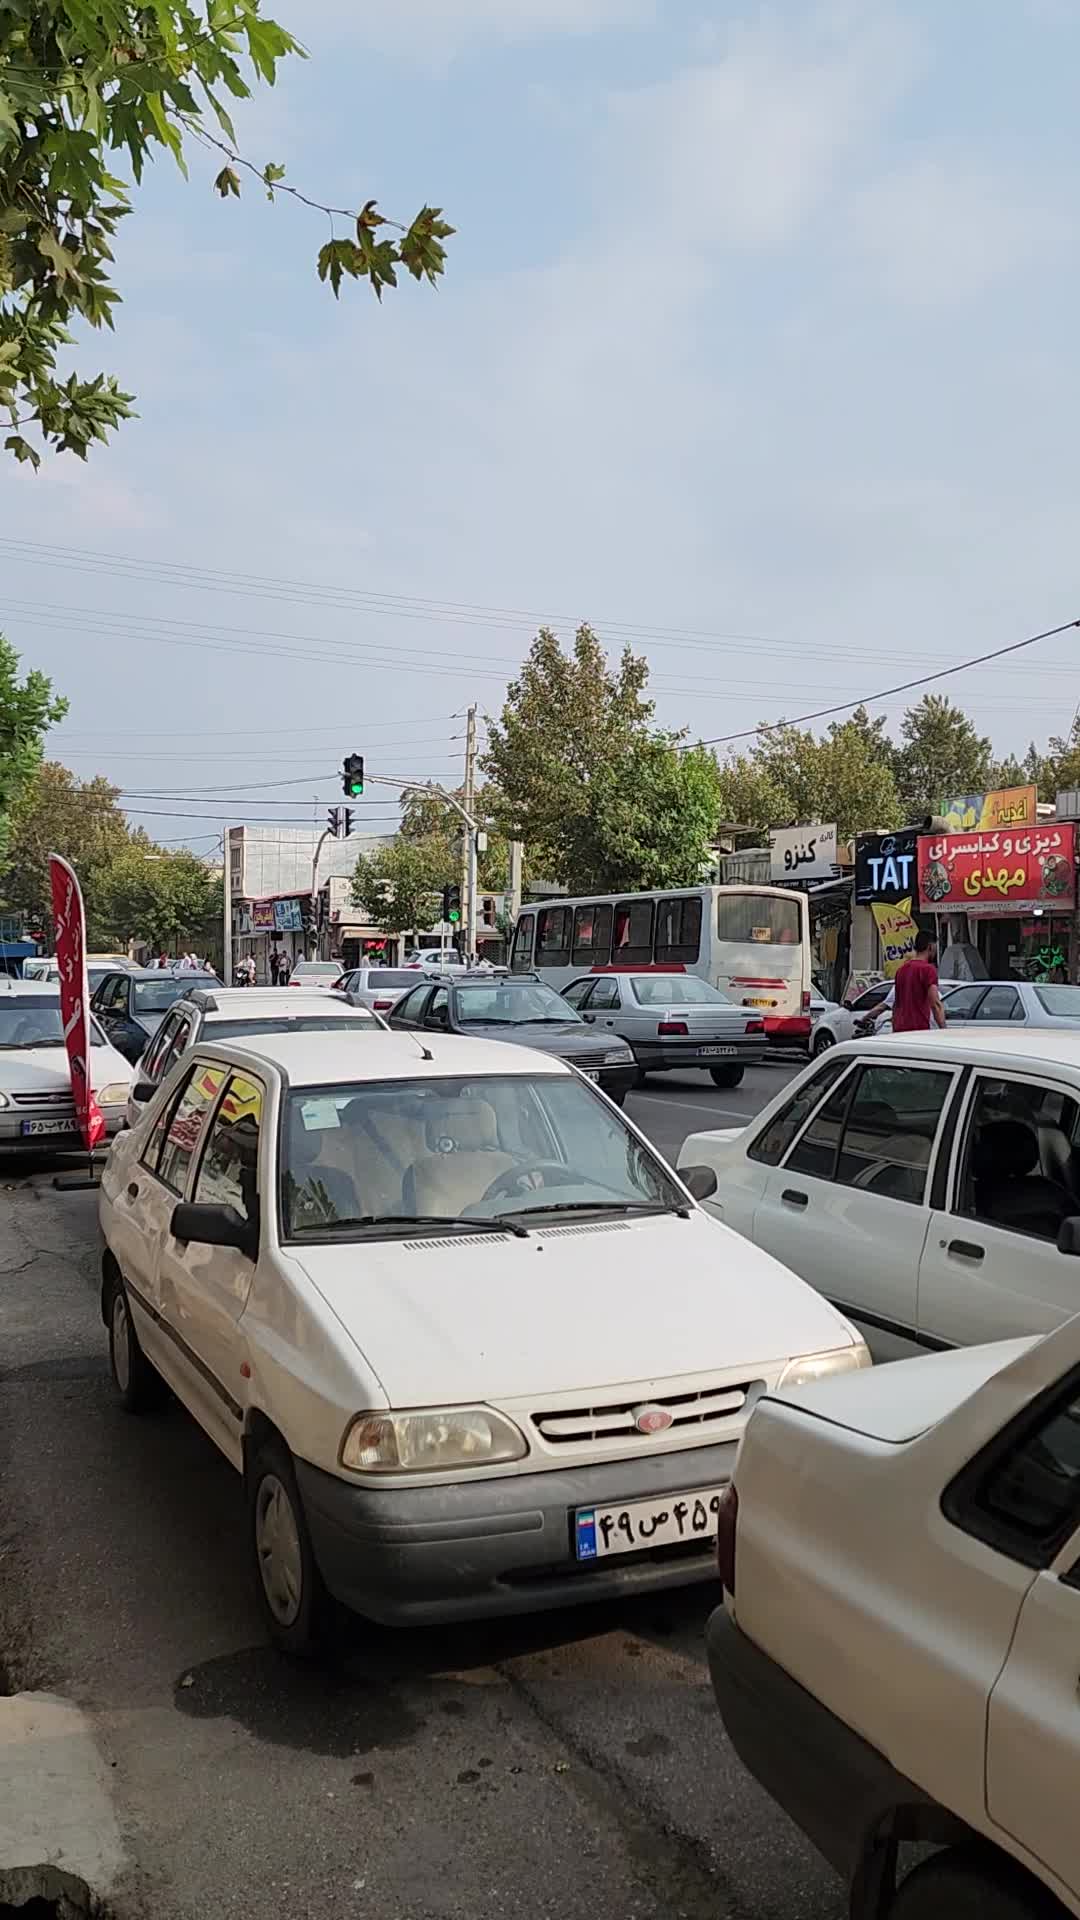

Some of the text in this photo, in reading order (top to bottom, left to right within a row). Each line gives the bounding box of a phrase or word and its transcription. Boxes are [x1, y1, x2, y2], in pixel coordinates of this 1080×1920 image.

[1002, 838, 1013, 856] و
[1015, 831, 1062, 856] دیزی
[867, 855, 915, 891] TAT
[963, 866, 1026, 896] مهدی
